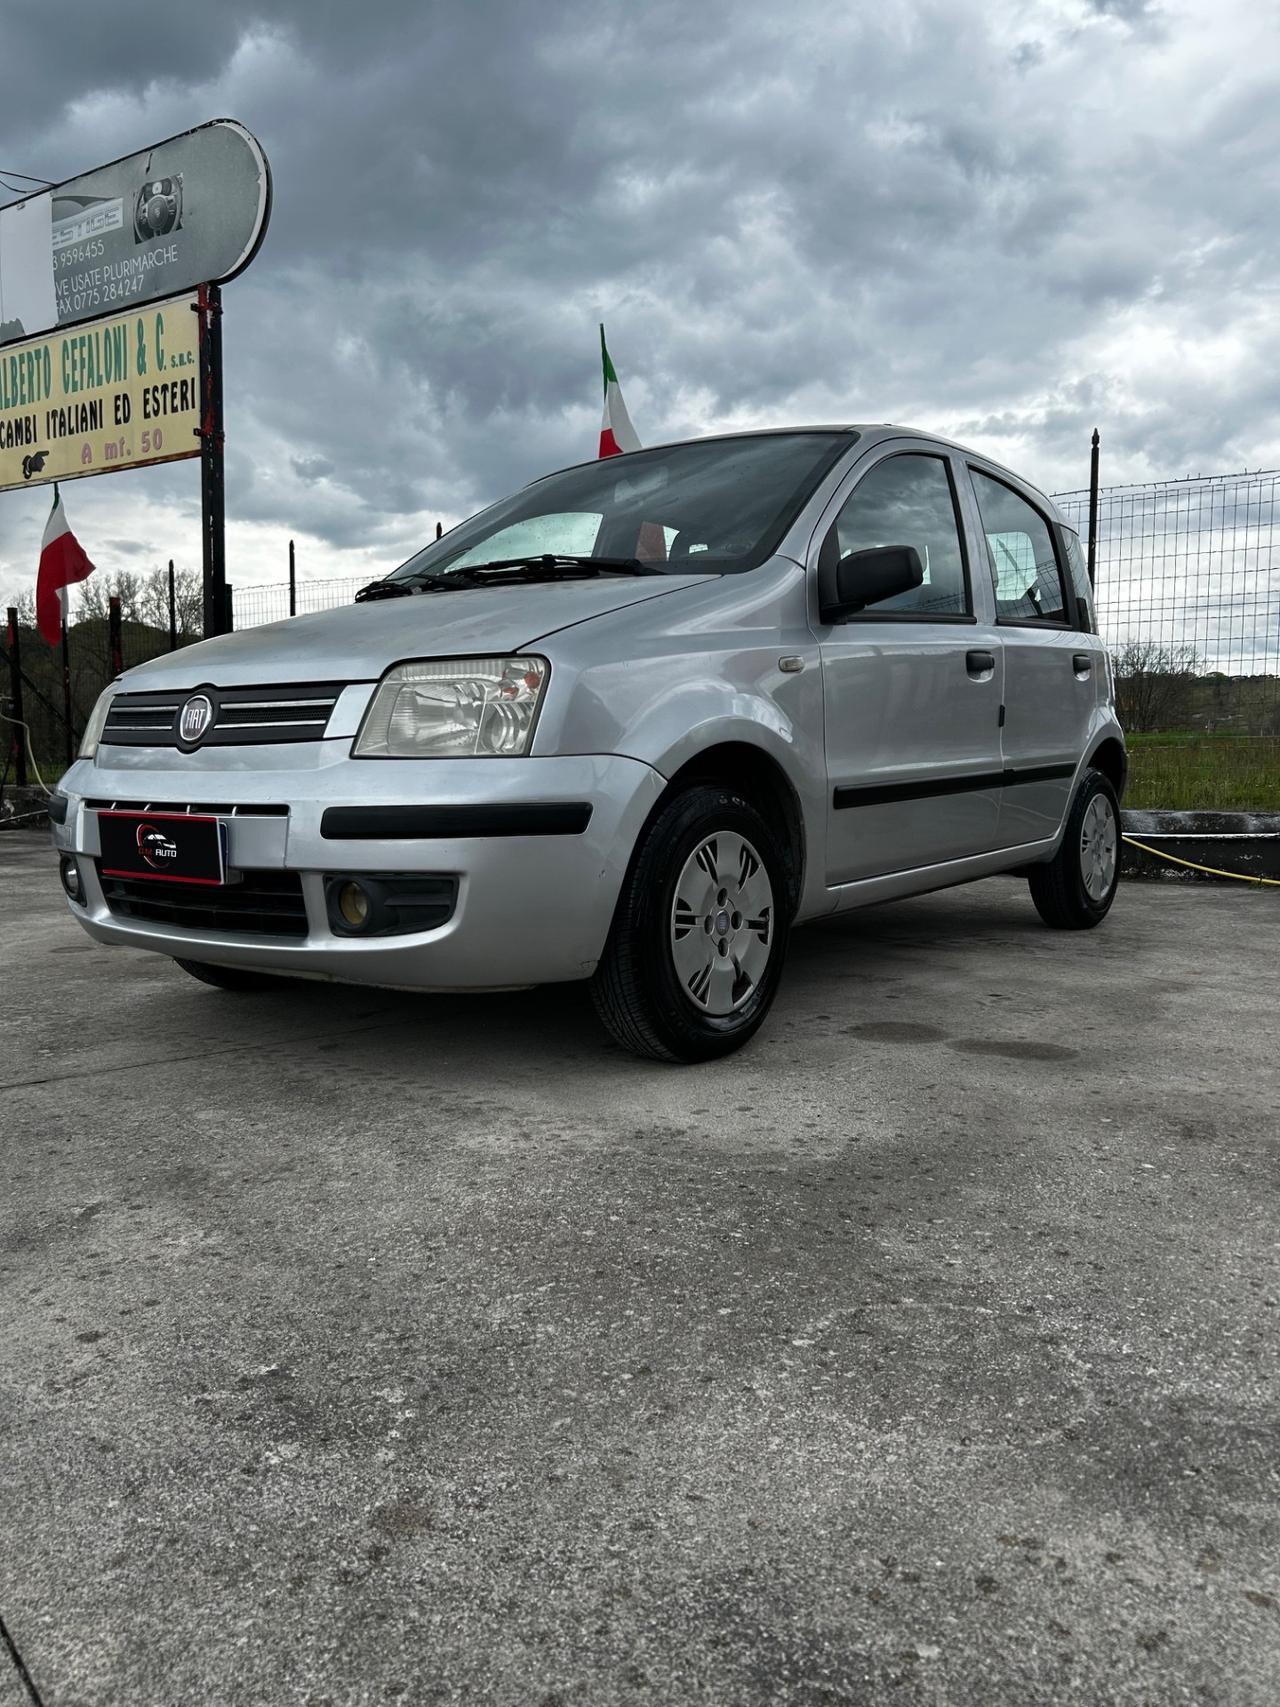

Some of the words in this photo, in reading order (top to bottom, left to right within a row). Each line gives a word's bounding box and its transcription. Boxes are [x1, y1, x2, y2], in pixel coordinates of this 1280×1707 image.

[60, 239, 105, 268] 9596455
[71, 268, 102, 292] USATE
[103, 244, 178, 281] PLURIMARCHE
[74, 288, 100, 310] 0775
[103, 275, 144, 302] 284247
[61, 324, 127, 394] CEFALONI
[136, 318, 147, 376] &
[156, 312, 167, 372] C.
[46, 398, 103, 440] ITALIANI
[114, 392, 131, 426] ED
[143, 377, 196, 420] ESTERI
[81, 442, 92, 465] A
[141, 428, 163, 453] 50
[185, 708, 206, 729] FIAT
[155, 848, 177, 858] AUTO
